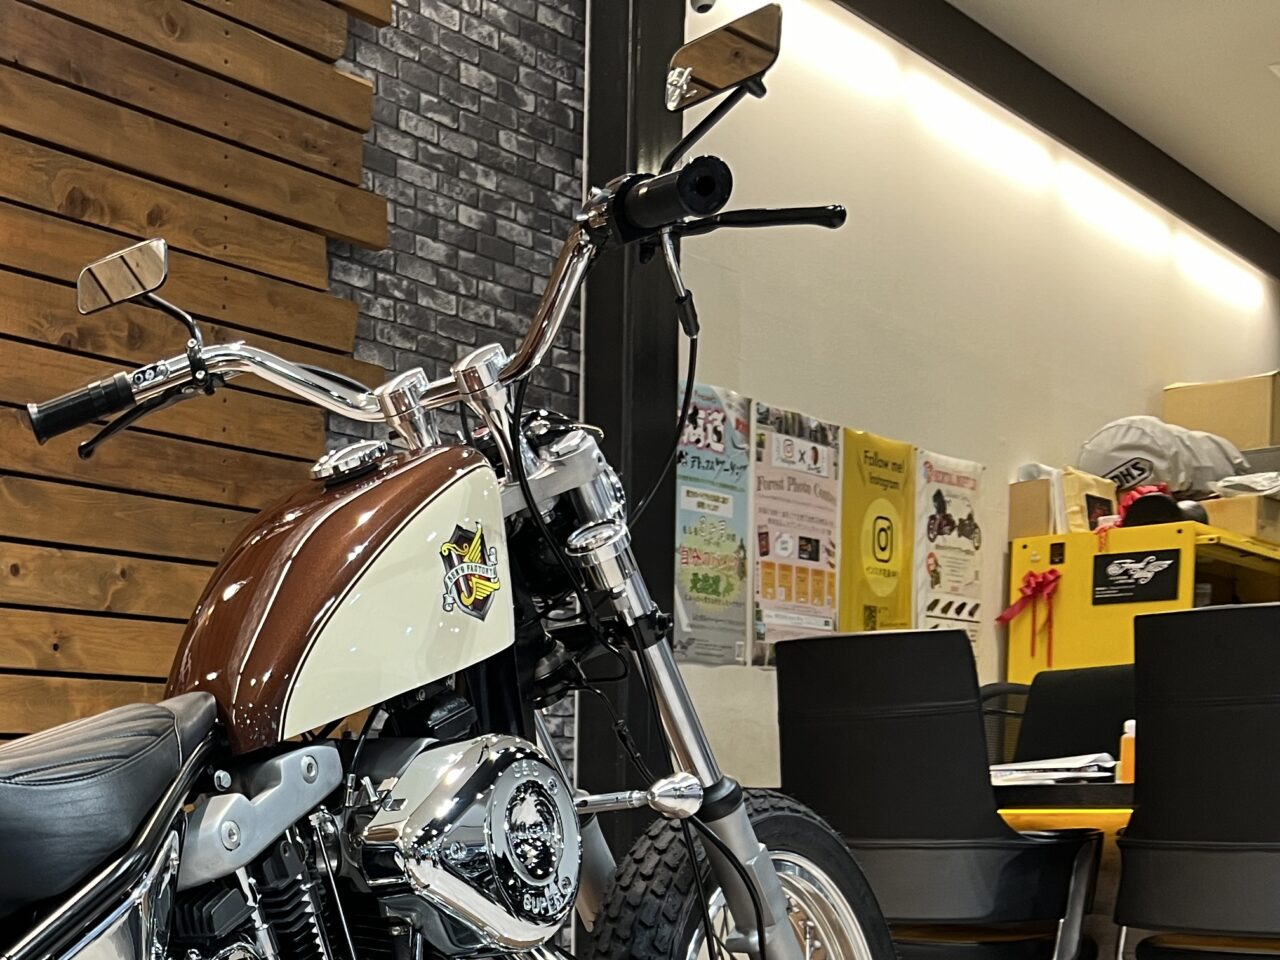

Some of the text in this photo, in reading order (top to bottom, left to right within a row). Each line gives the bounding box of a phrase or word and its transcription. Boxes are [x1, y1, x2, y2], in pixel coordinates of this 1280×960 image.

[863, 450, 889, 469] Follow
[1110, 461, 1147, 487] SHO
[756, 475, 785, 492] Forest
[787, 475, 812, 496] Photo
